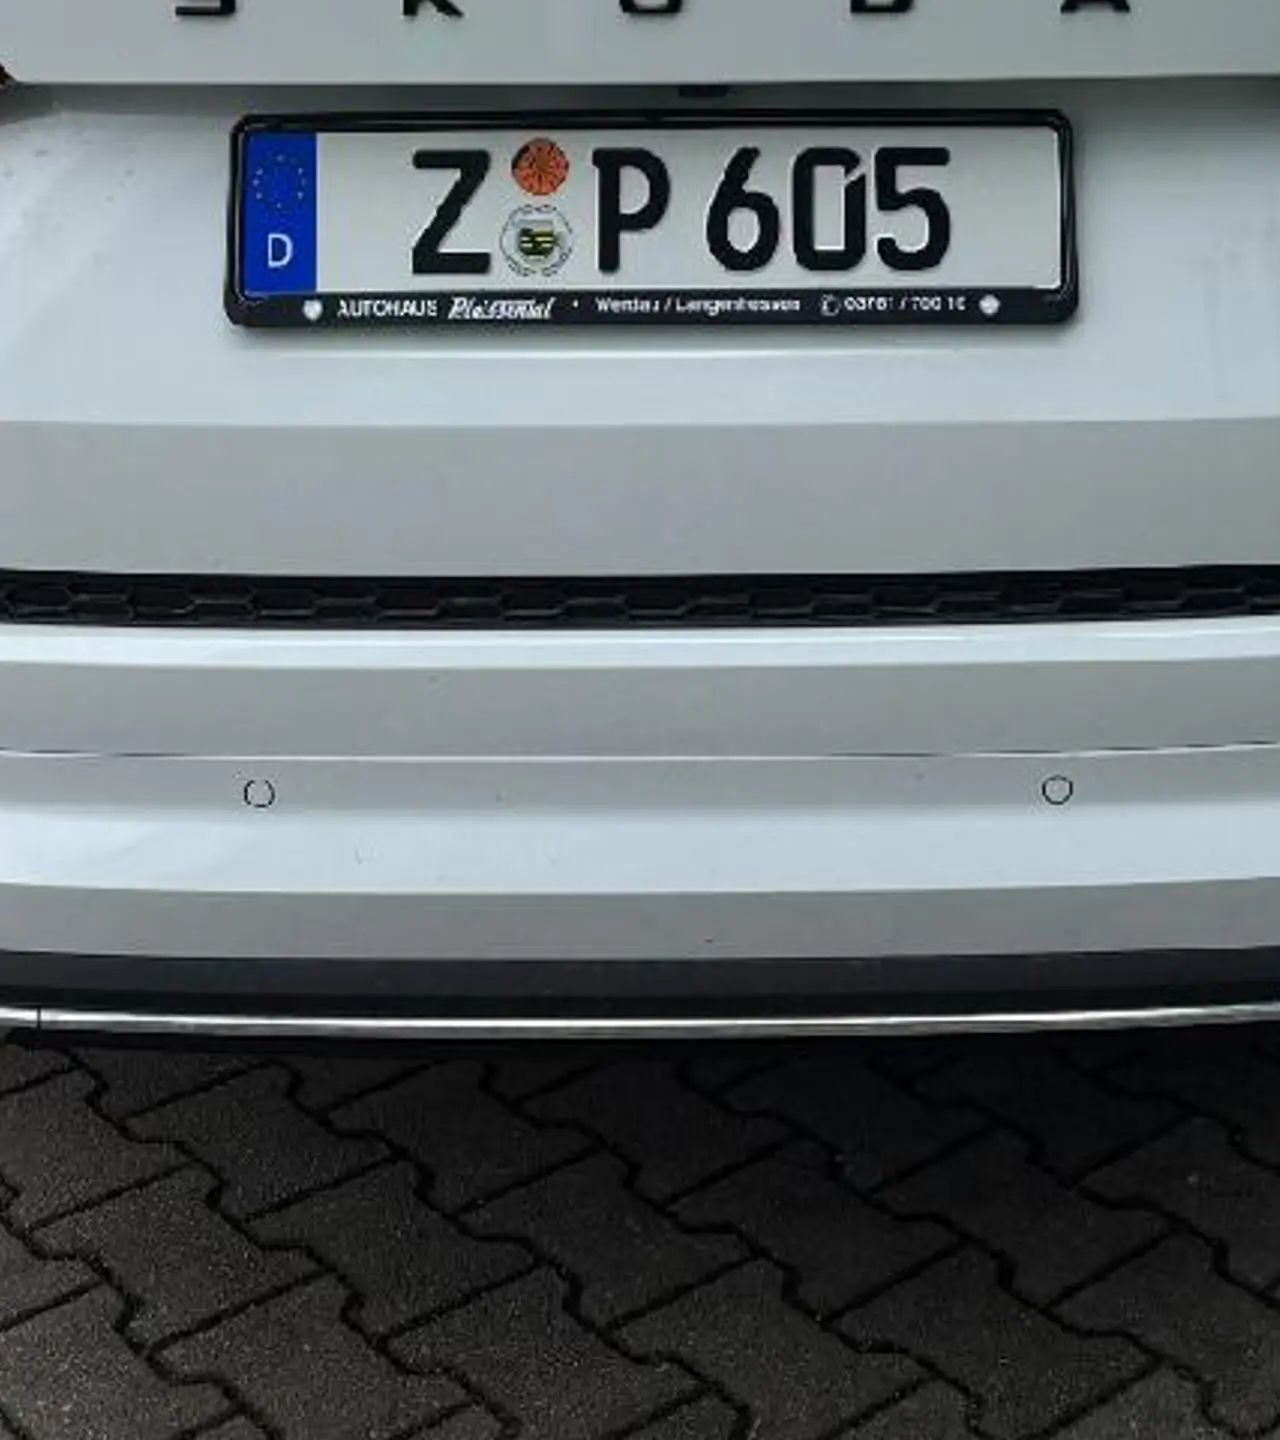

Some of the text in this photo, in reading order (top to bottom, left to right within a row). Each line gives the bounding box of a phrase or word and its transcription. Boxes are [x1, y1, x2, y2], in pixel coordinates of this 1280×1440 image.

[412, 146, 951, 275] Z P 605
[267, 233, 294, 268] D
[336, 299, 438, 318] AUTOHAUS
